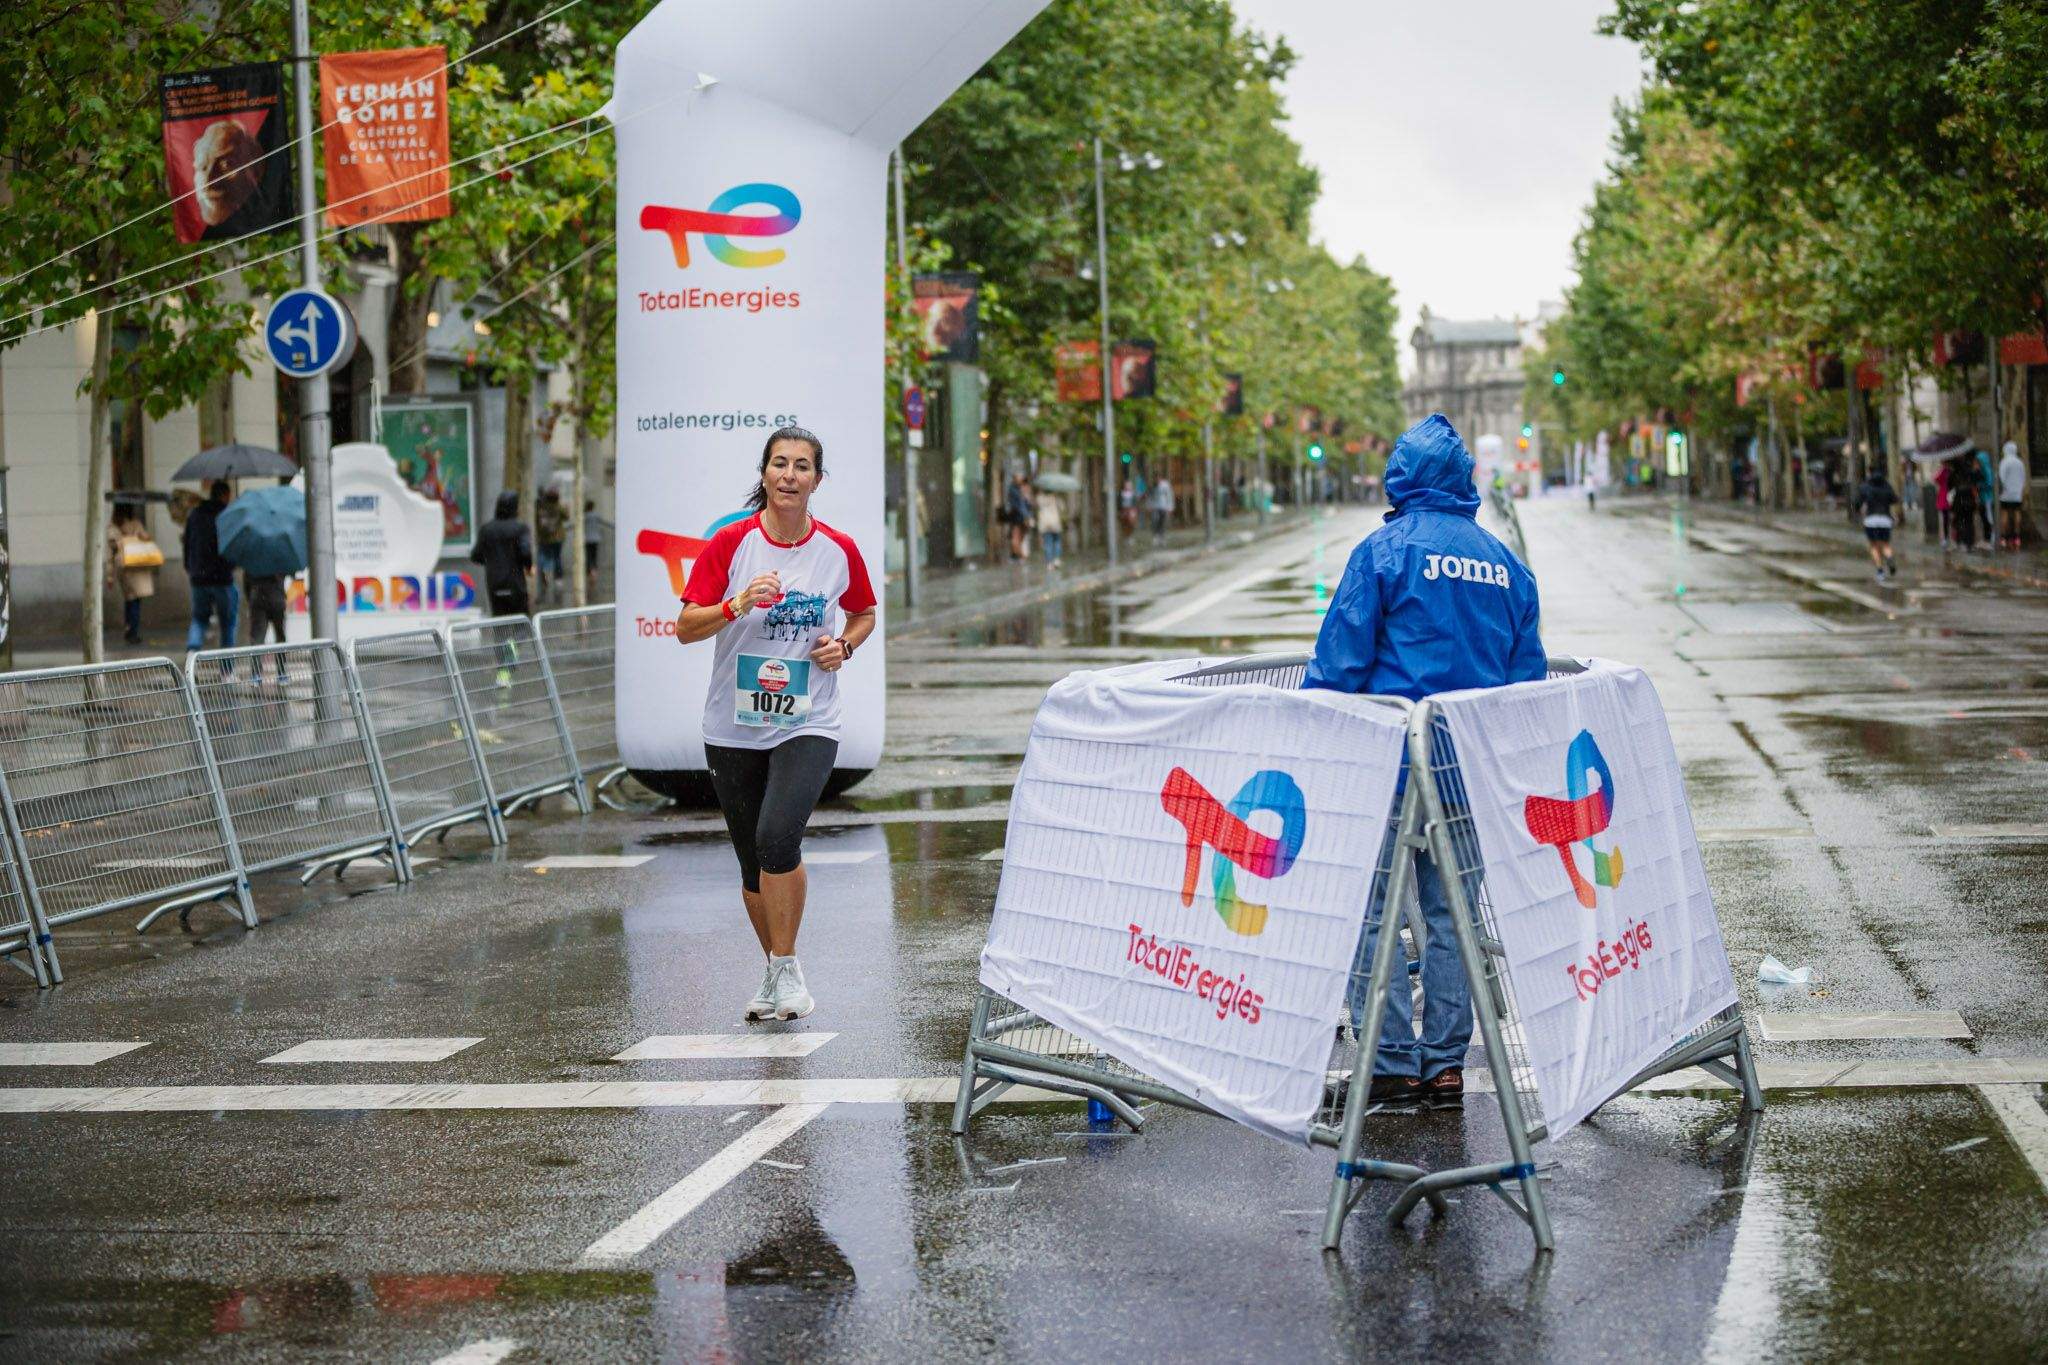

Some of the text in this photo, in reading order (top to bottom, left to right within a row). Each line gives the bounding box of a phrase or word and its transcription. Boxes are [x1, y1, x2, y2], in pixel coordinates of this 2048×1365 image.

[336, 77, 435, 103] FERNÁN
[337, 102, 436, 124] GÓMEZ
[357, 124, 417, 138] CENTRO
[349, 137, 428, 151] CULTURAL
[340, 149, 438, 165] DE LA VILLA
[639, 286, 801, 313] TotalEnergies
[637, 410, 798, 432] totalenergies.es
[751, 692, 795, 716] 1072
